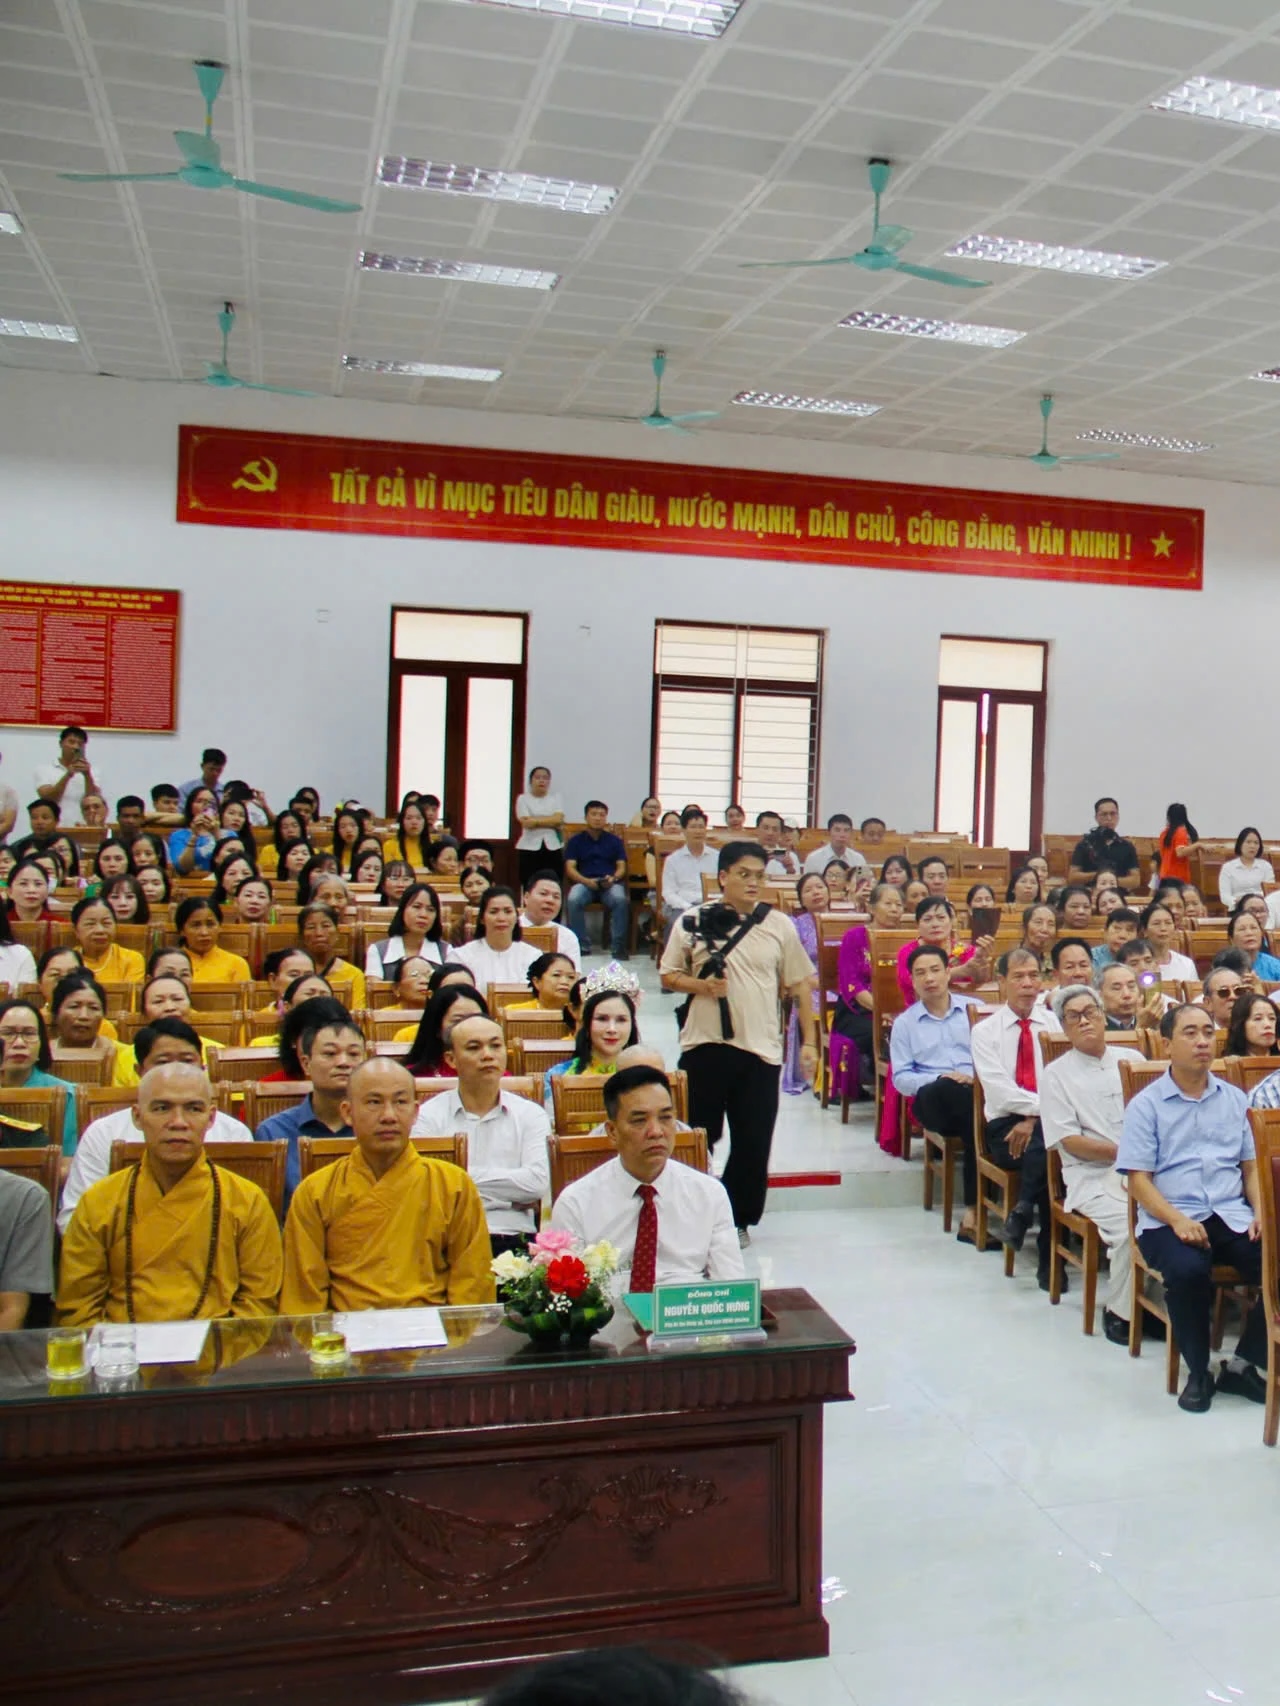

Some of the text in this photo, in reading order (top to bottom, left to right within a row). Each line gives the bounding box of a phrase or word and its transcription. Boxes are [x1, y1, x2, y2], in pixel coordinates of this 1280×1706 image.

[330, 467, 370, 504] TẤT
[376, 468, 406, 507] CẢ
[414, 472, 437, 509] VÌ
[443, 481, 494, 518] MỤC
[503, 479, 547, 516] TIÊU
[555, 483, 598, 519] DÂN
[606, 489, 660, 527] GIÀU,
[668, 493, 726, 529] NƯỚC
[733, 502, 802, 538] MẠNH,
[809, 503, 849, 538] DÂN
[855, 505, 901, 546] CHỦ,
[908, 511, 959, 547] CÔNG
[1028, 522, 1064, 555] VĂN
[1070, 529, 1120, 560] MINH
[1124, 533, 1132, 561] !
[664, 1301, 699, 1317] NGUYỄN
[701, 1300, 723, 1316] QUỐC
